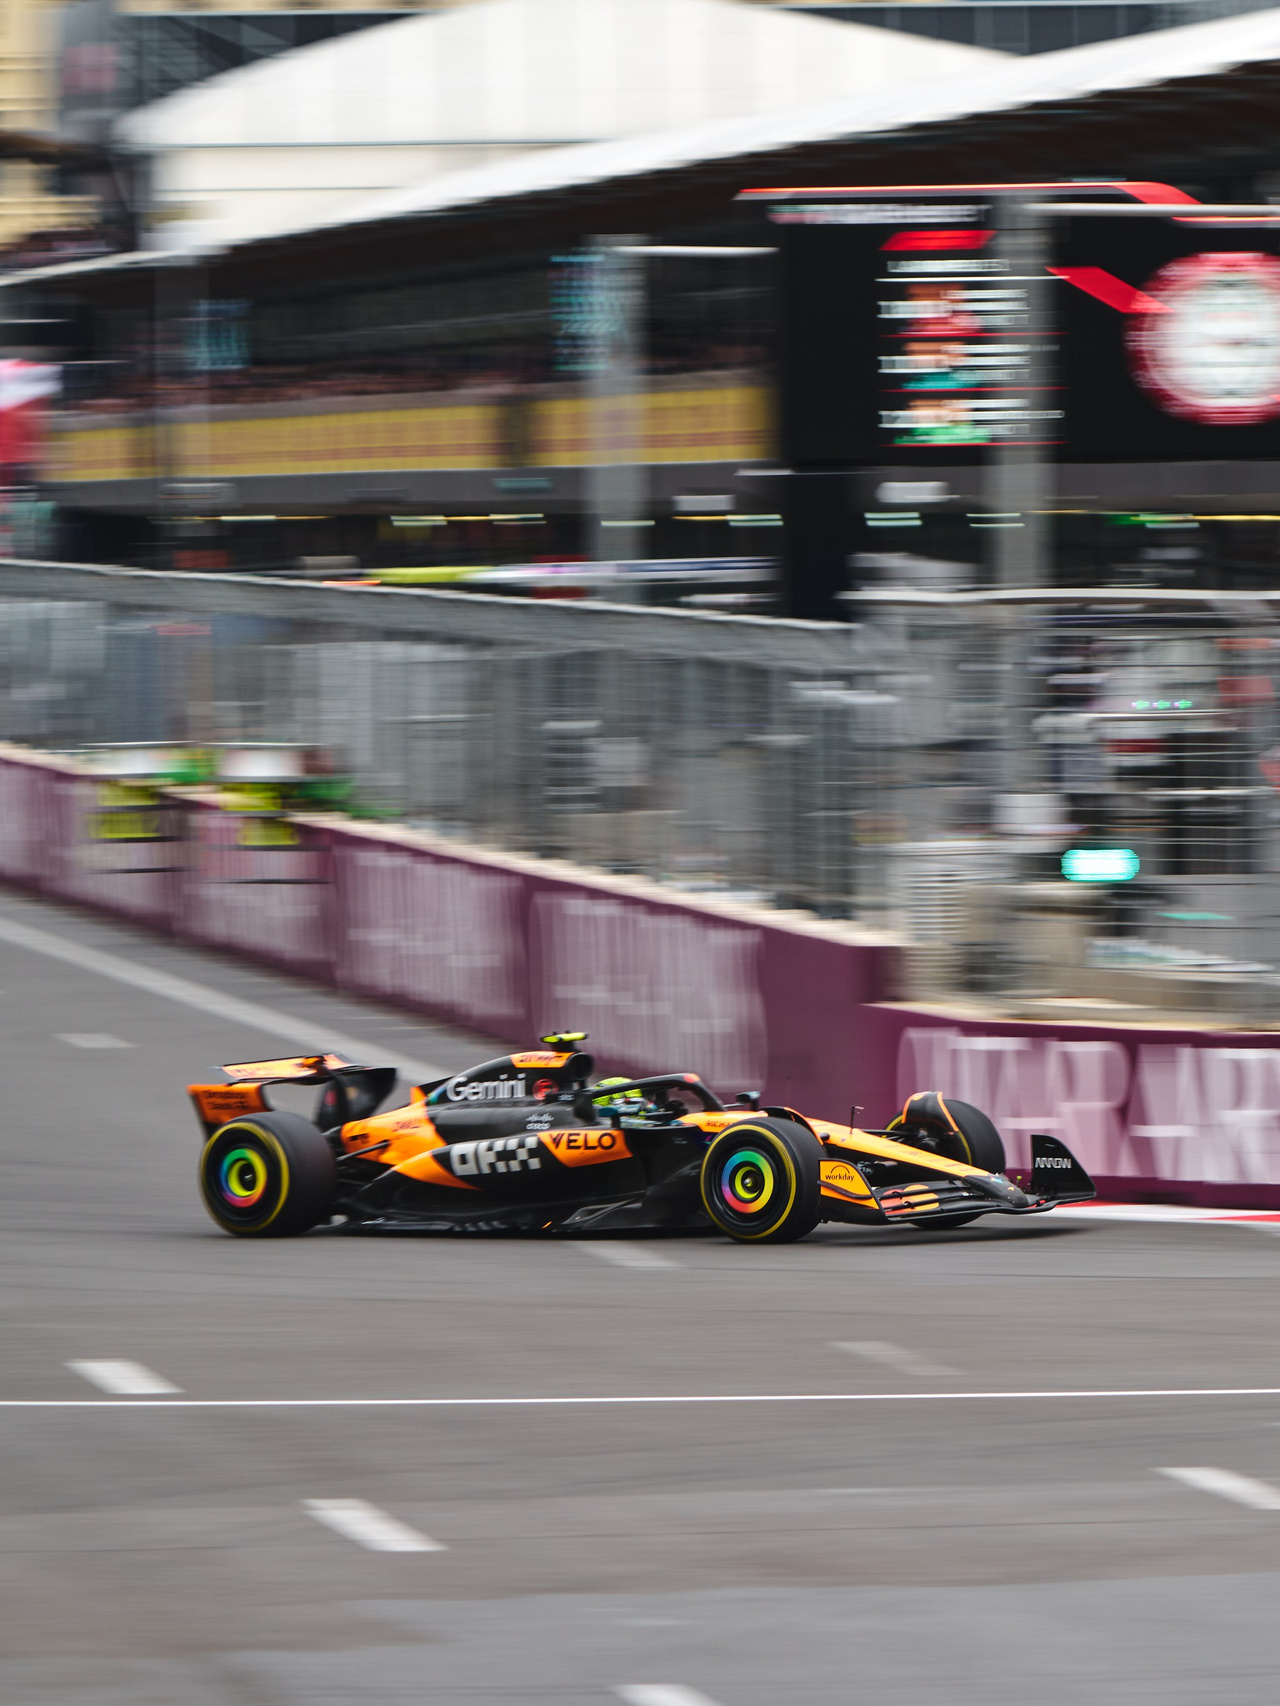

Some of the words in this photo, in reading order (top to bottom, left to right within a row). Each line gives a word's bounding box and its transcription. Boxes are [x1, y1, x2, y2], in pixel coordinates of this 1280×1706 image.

[447, 1073, 526, 1101] Gemini
[550, 1132, 615, 1150] VELO
[451, 1136, 542, 1176] OKX
[825, 1173, 855, 1182] workday
